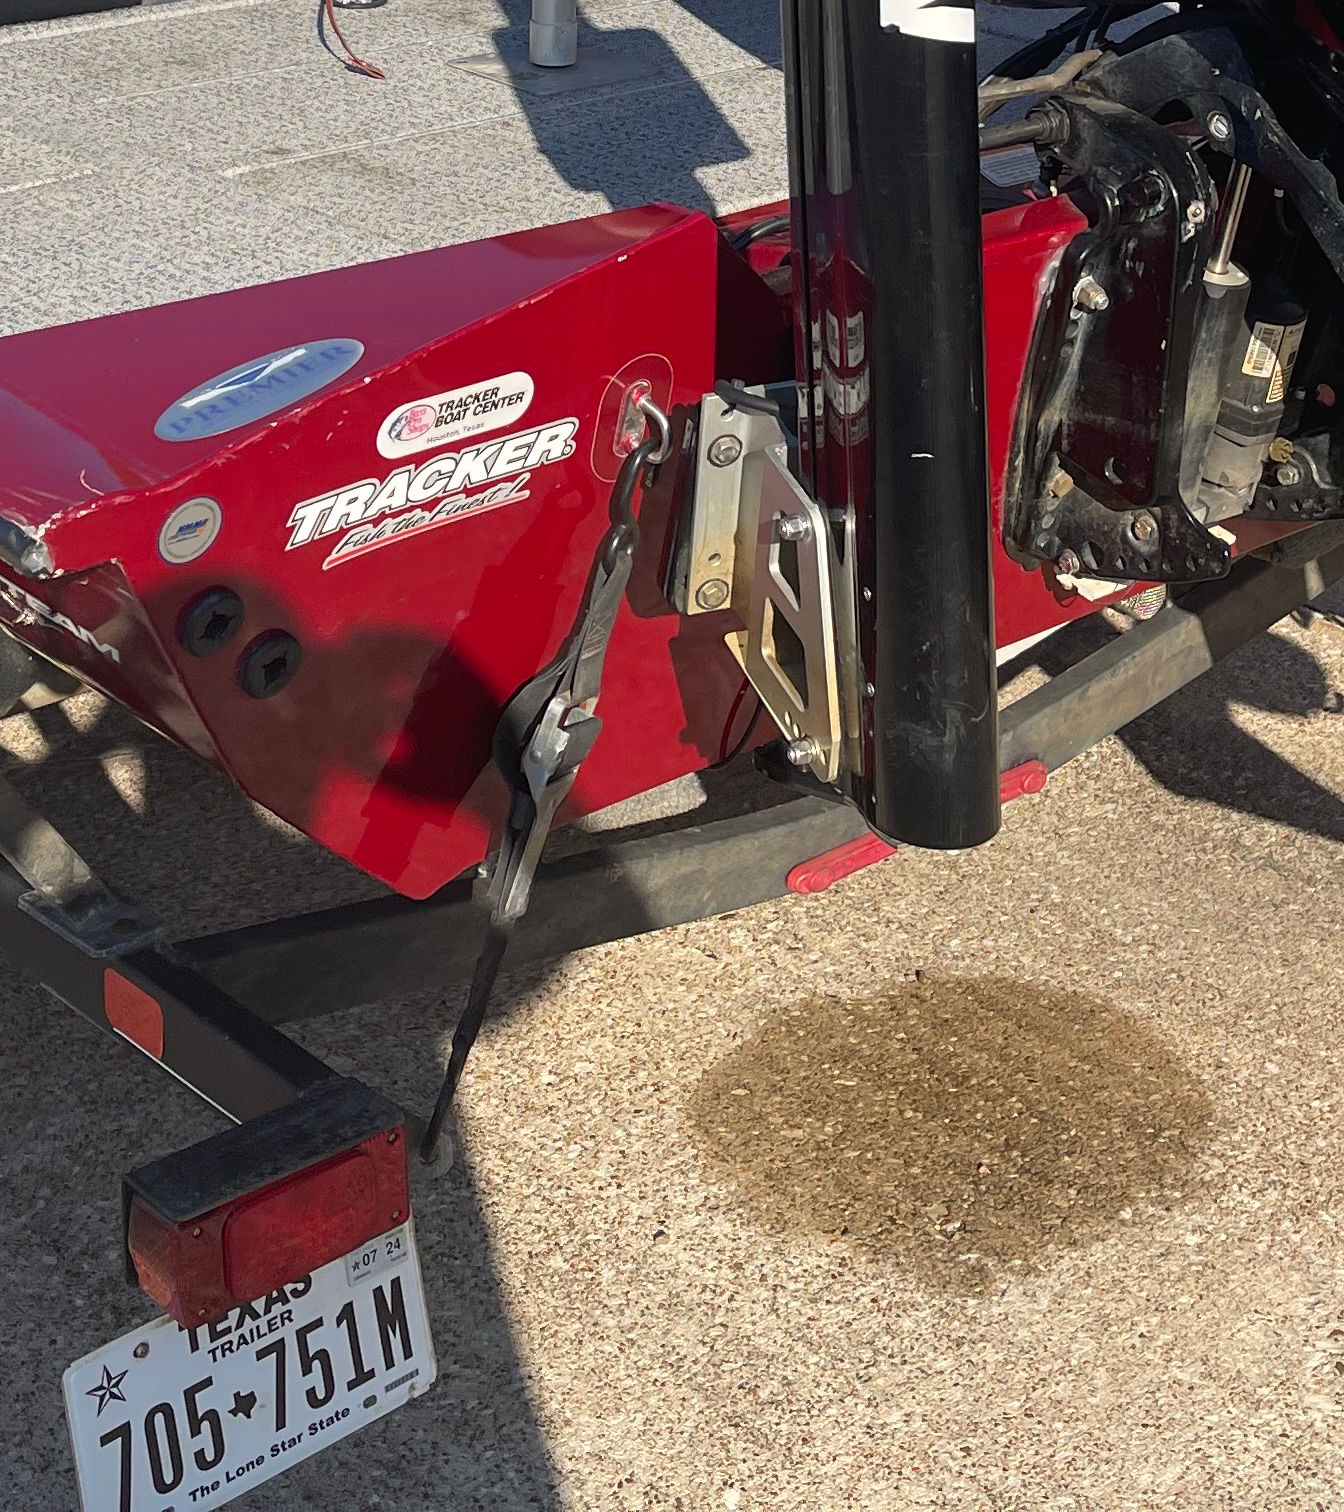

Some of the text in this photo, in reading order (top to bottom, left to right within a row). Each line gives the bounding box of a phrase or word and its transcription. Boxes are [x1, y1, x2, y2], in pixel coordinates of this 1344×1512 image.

[169, 345, 354, 434] PREMIER
[435, 391, 526, 428] BOAT CENTER
[438, 386, 500, 414] TRACKER
[462, 422, 485, 434] Texas
[336, 529, 387, 554] Fish
[391, 513, 427, 533] the
[362, 1248, 377, 1266] 07
[385, 1237, 401, 1256] 24
[207, 1309, 295, 1364] TRAILER
[99, 1275, 415, 1512] 705 751M
[188, 1405, 352, 1503] The Lone Star State
